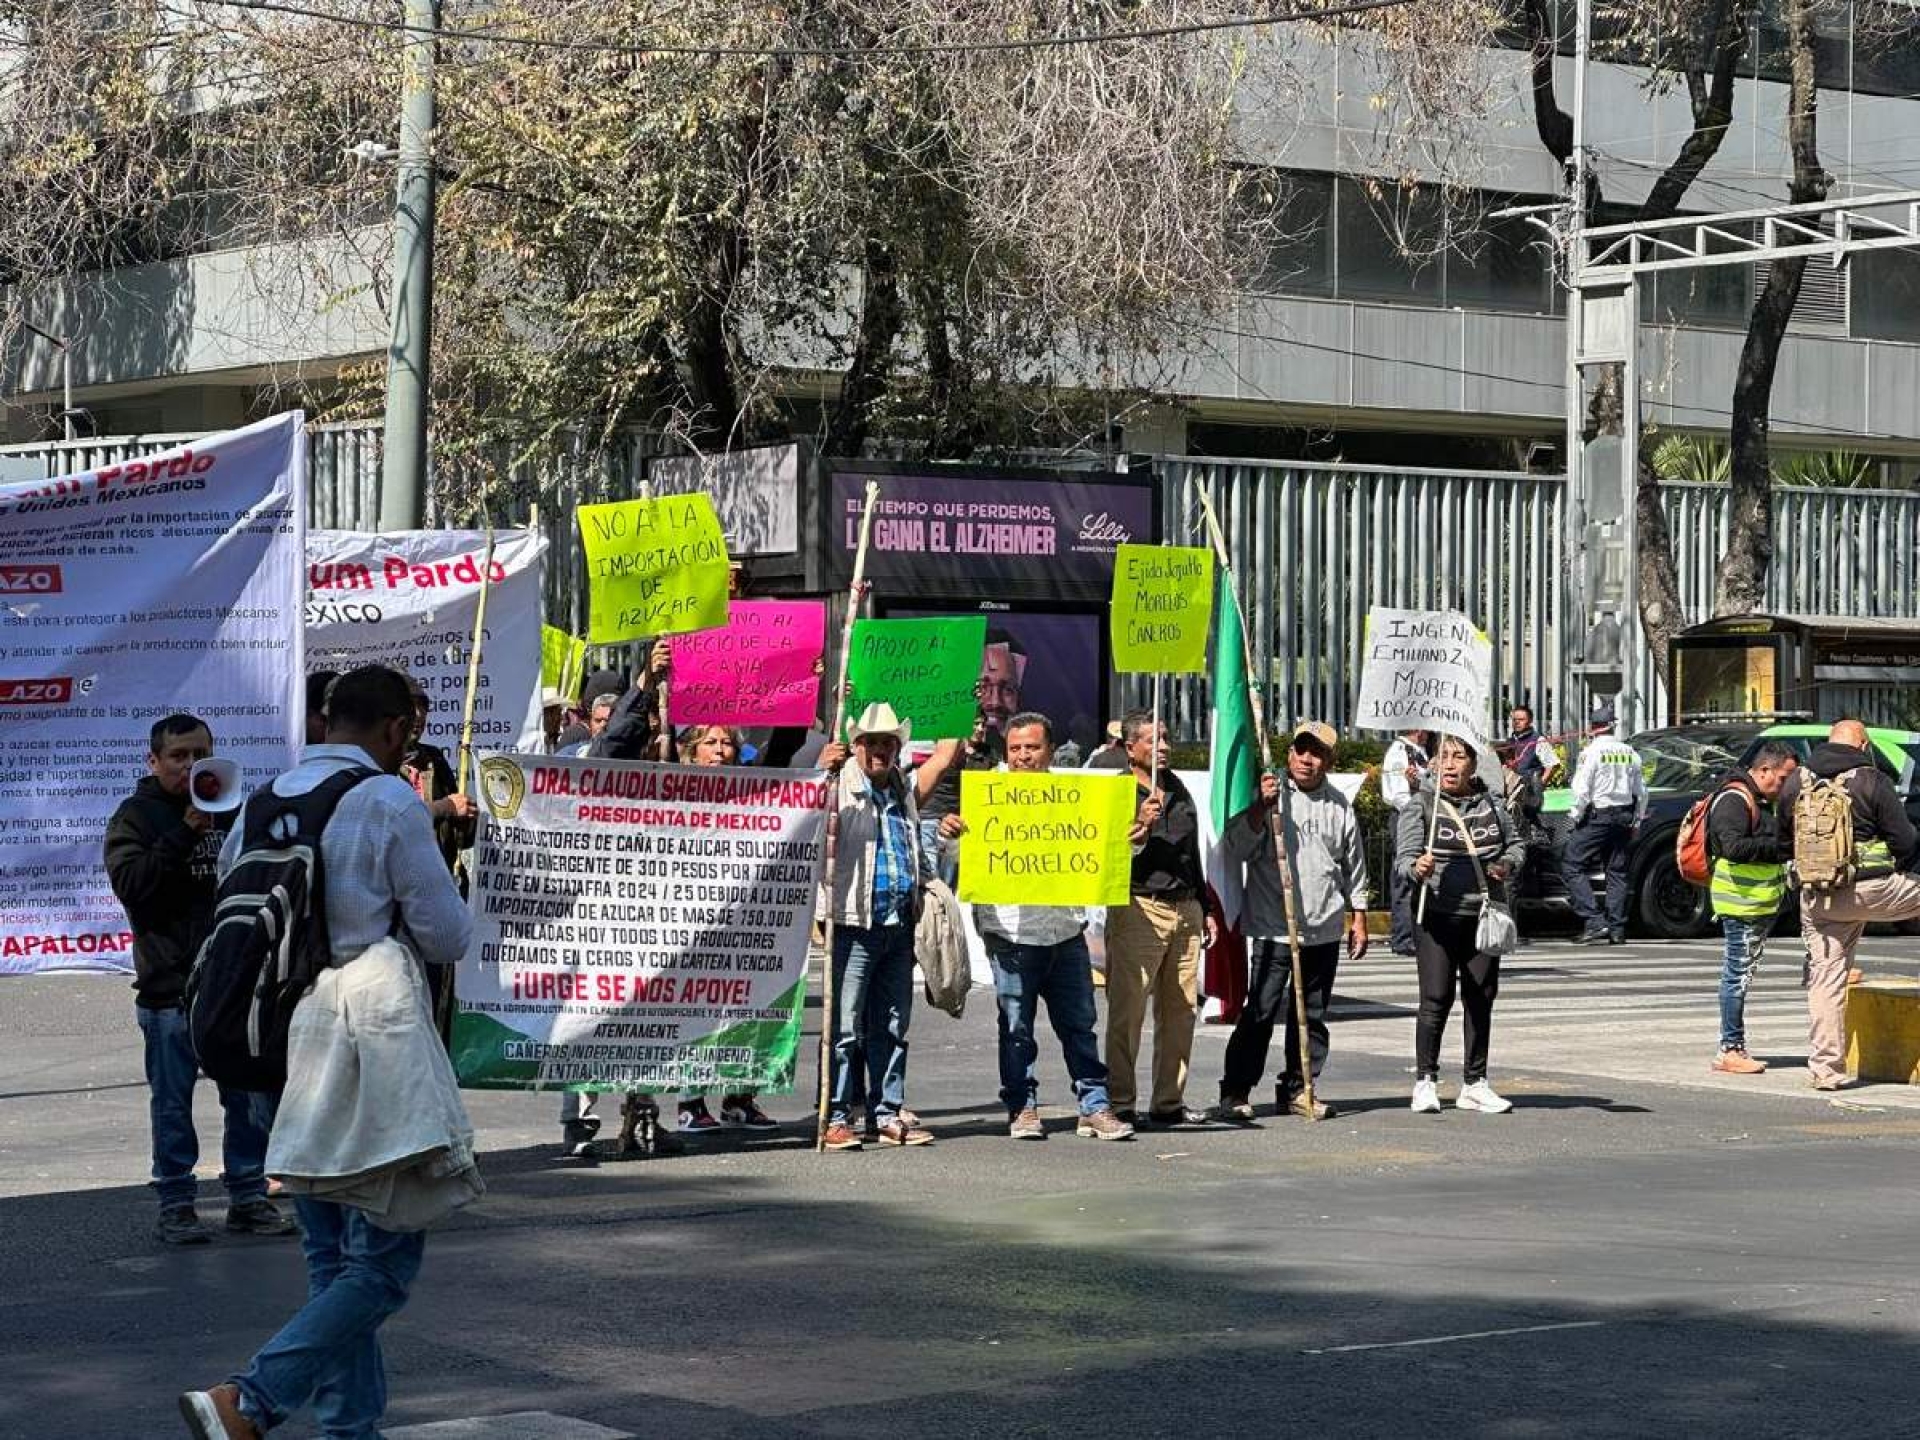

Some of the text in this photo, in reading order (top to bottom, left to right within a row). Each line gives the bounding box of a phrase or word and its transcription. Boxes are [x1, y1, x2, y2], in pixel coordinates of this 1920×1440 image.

[97, 479, 206, 503] Mexicanos
[592, 503, 698, 541] NO A LA
[847, 499, 1056, 524] EL TIEMPO QUE PERDEMOS,
[874, 519, 925, 551] GANA
[930, 521, 950, 553] EL
[955, 522, 1057, 555] ALZHEIMER
[1080, 511, 1132, 544] Lilly
[596, 530, 720, 577] IMPORTACIÓN
[384, 555, 505, 589] Pardo
[641, 575, 665, 600] DE
[216, 606, 278, 620] Mexicanos
[1136, 589, 1188, 613] MORELOS
[672, 634, 793, 654] PRECIO DE LA
[1127, 619, 1182, 647] CAÑEROS
[414, 651, 436, 667] de
[863, 634, 919, 659] APOYO
[1372, 644, 1447, 663] EMILIANO
[880, 663, 943, 684] CAMPO
[1371, 700, 1417, 718] 100%
[54, 752, 92, 766] buena
[532, 767, 576, 795] DRA.
[579, 768, 657, 800] CLAUDIA
[661, 772, 768, 805] SHEINBAUM
[768, 780, 827, 809] PARDO
[983, 781, 1081, 807] INGENIO
[12, 818, 61, 831] ninguna
[578, 805, 782, 831] PRESIDENTA DE MEXICO
[983, 816, 1098, 843] CASASANO
[595, 834, 613, 851] DE
[616, 830, 652, 854] CAÑA
[657, 838, 674, 855] DE
[678, 838, 731, 857] AZUCAR
[736, 841, 819, 861] SOLICITAMOS
[503, 850, 533, 869] PLAN
[537, 853, 611, 875] EMERGENTE
[616, 858, 635, 875] DE
[638, 859, 667, 877] 300
[672, 861, 718, 879] PESOS
[722, 863, 749, 881] POR
[755, 864, 811, 884] TONELADA
[988, 850, 1100, 876] MORELOS
[493, 873, 521, 892] QUE
[523, 876, 539, 894] EN
[618, 882, 657, 900] 2024
[674, 885, 694, 901] 25
[698, 886, 747, 903] DEBIDO
[749, 887, 758, 904] A
[761, 887, 772, 904] LA
[775, 888, 809, 906] LIBRE
[578, 903, 598, 919] DE
[601, 903, 654, 922] AZUCAR
[661, 906, 678, 923] DE
[683, 907, 714, 925] MAS
[717, 909, 734, 925] DE
[499, 921, 775, 950] TONELADAS HOY TODOS LOS PRODUCTORES
[481, 943, 784, 971] QUEDAMOS EN CEROS Y CON CARTERA VENCIDA
[514, 973, 752, 1006] ¡URGE SE NOS APOYE!
[593, 1023, 680, 1039] ATENTAMENTE
[571, 1045, 675, 1063] INDEPENDIENTES
[703, 1048, 752, 1063] INGENIO
